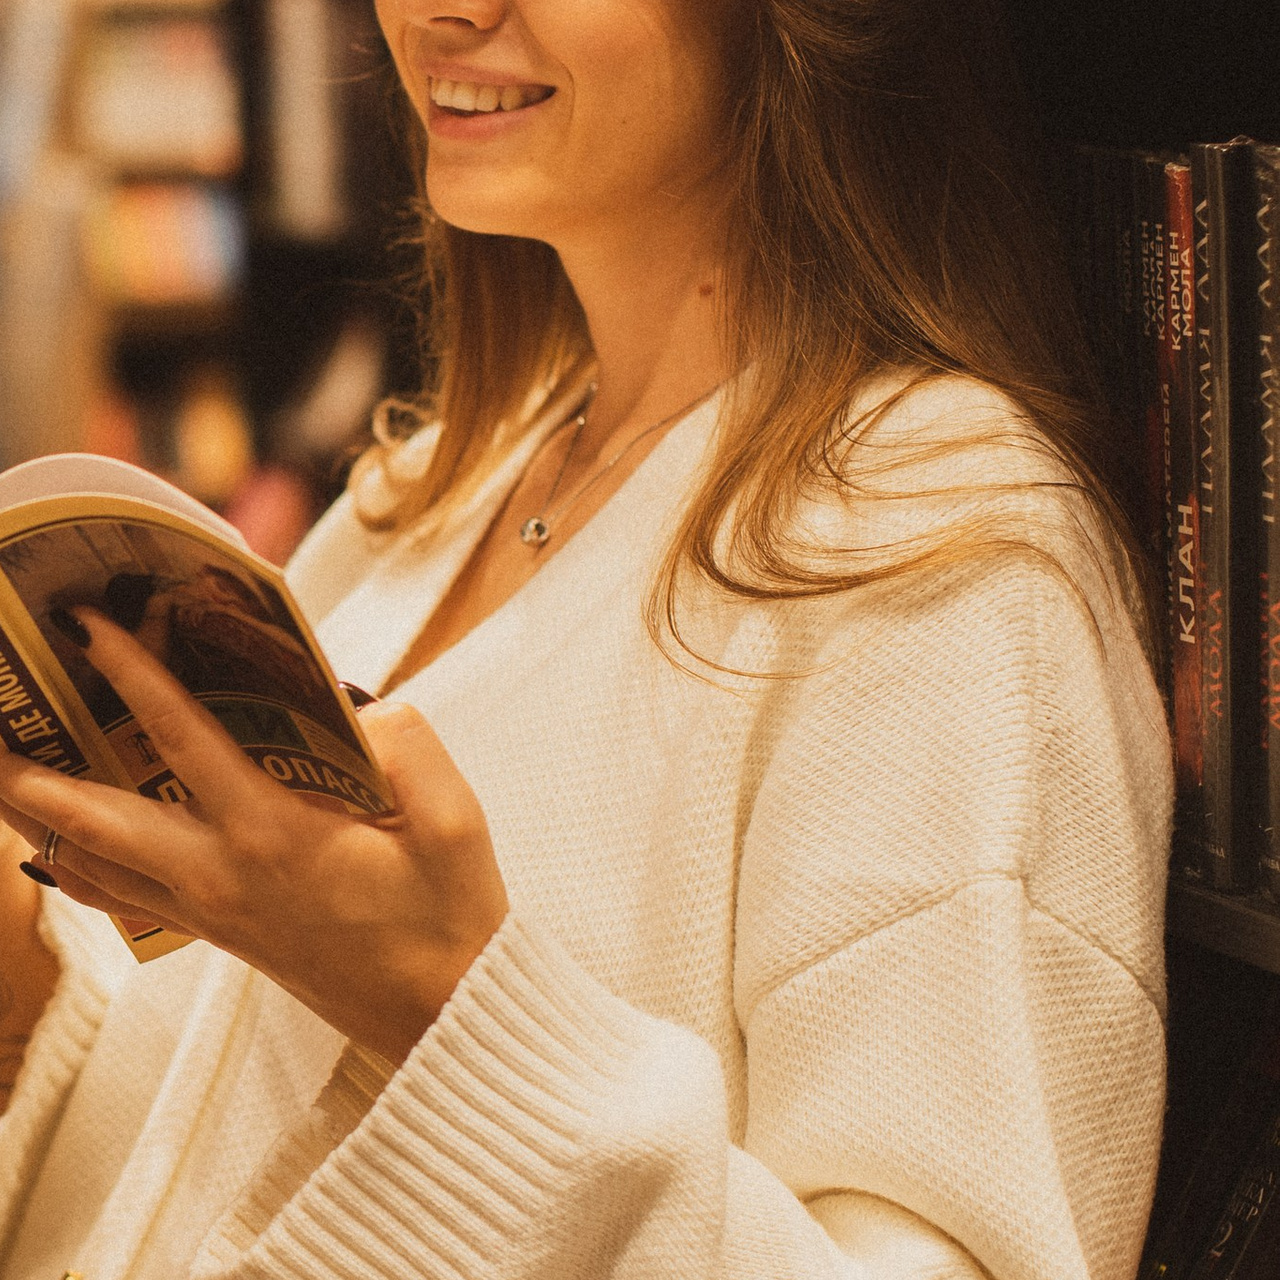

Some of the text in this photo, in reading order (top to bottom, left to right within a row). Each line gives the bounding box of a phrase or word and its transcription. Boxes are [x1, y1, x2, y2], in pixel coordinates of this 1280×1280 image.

[1141, 220, 1151, 337] КАРМЕН
[1155, 222, 1166, 342] КАРМЕН
[1169, 231, 1182, 352] КАРМЕН
[1180, 246, 1193, 338] МОЛА
[1177, 503, 1196, 646] КЛАН
[1208, 588, 1224, 718] МОЛА
[9, 708, 58, 744] ДЕ
